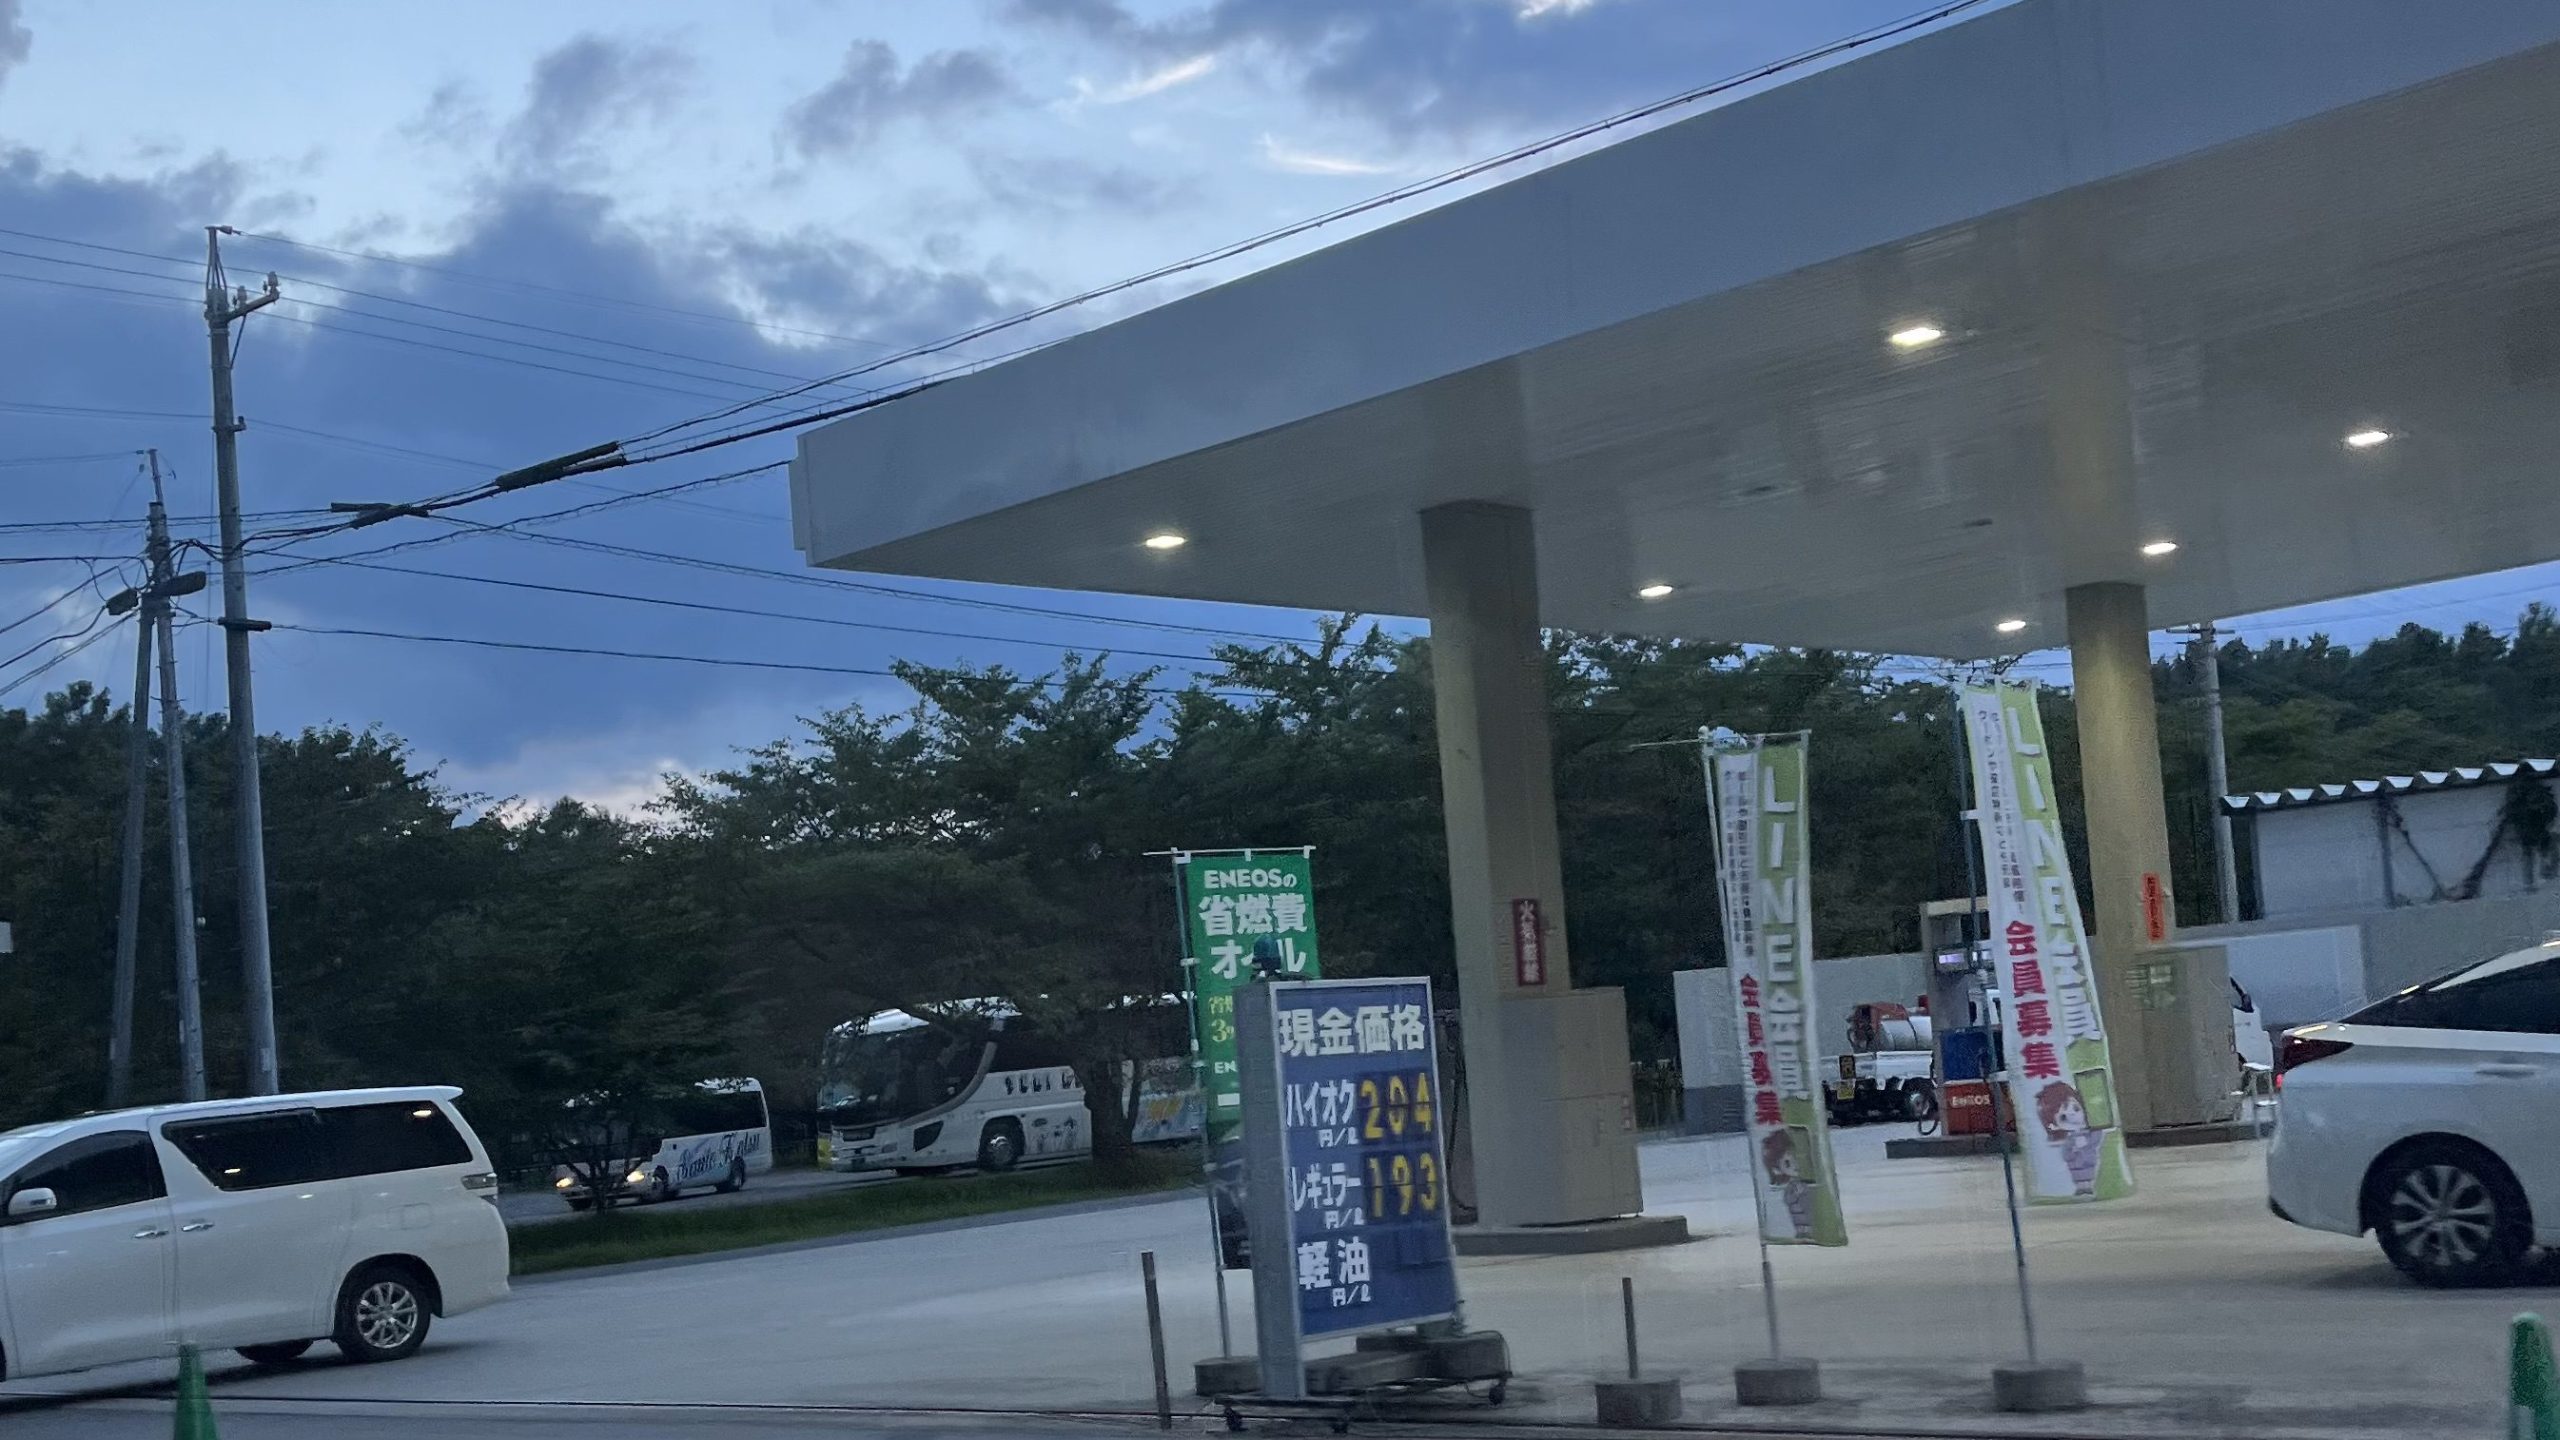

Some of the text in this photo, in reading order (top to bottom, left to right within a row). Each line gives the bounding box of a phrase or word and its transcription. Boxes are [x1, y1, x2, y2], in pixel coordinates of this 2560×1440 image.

[1203, 868, 1298, 889] ENEOSの
[1199, 893, 1308, 936] 省燃費
[2006, 920, 2060, 1079] 会員募集
[1278, 1005, 1425, 1057] 現金価格
[1740, 974, 1783, 1126] 会員募集
[1286, 1072, 1432, 1139] ハイオク 204
[1291, 1152, 1437, 1218] レギュラー 193
[1297, 1236, 1370, 1290] 軽油
